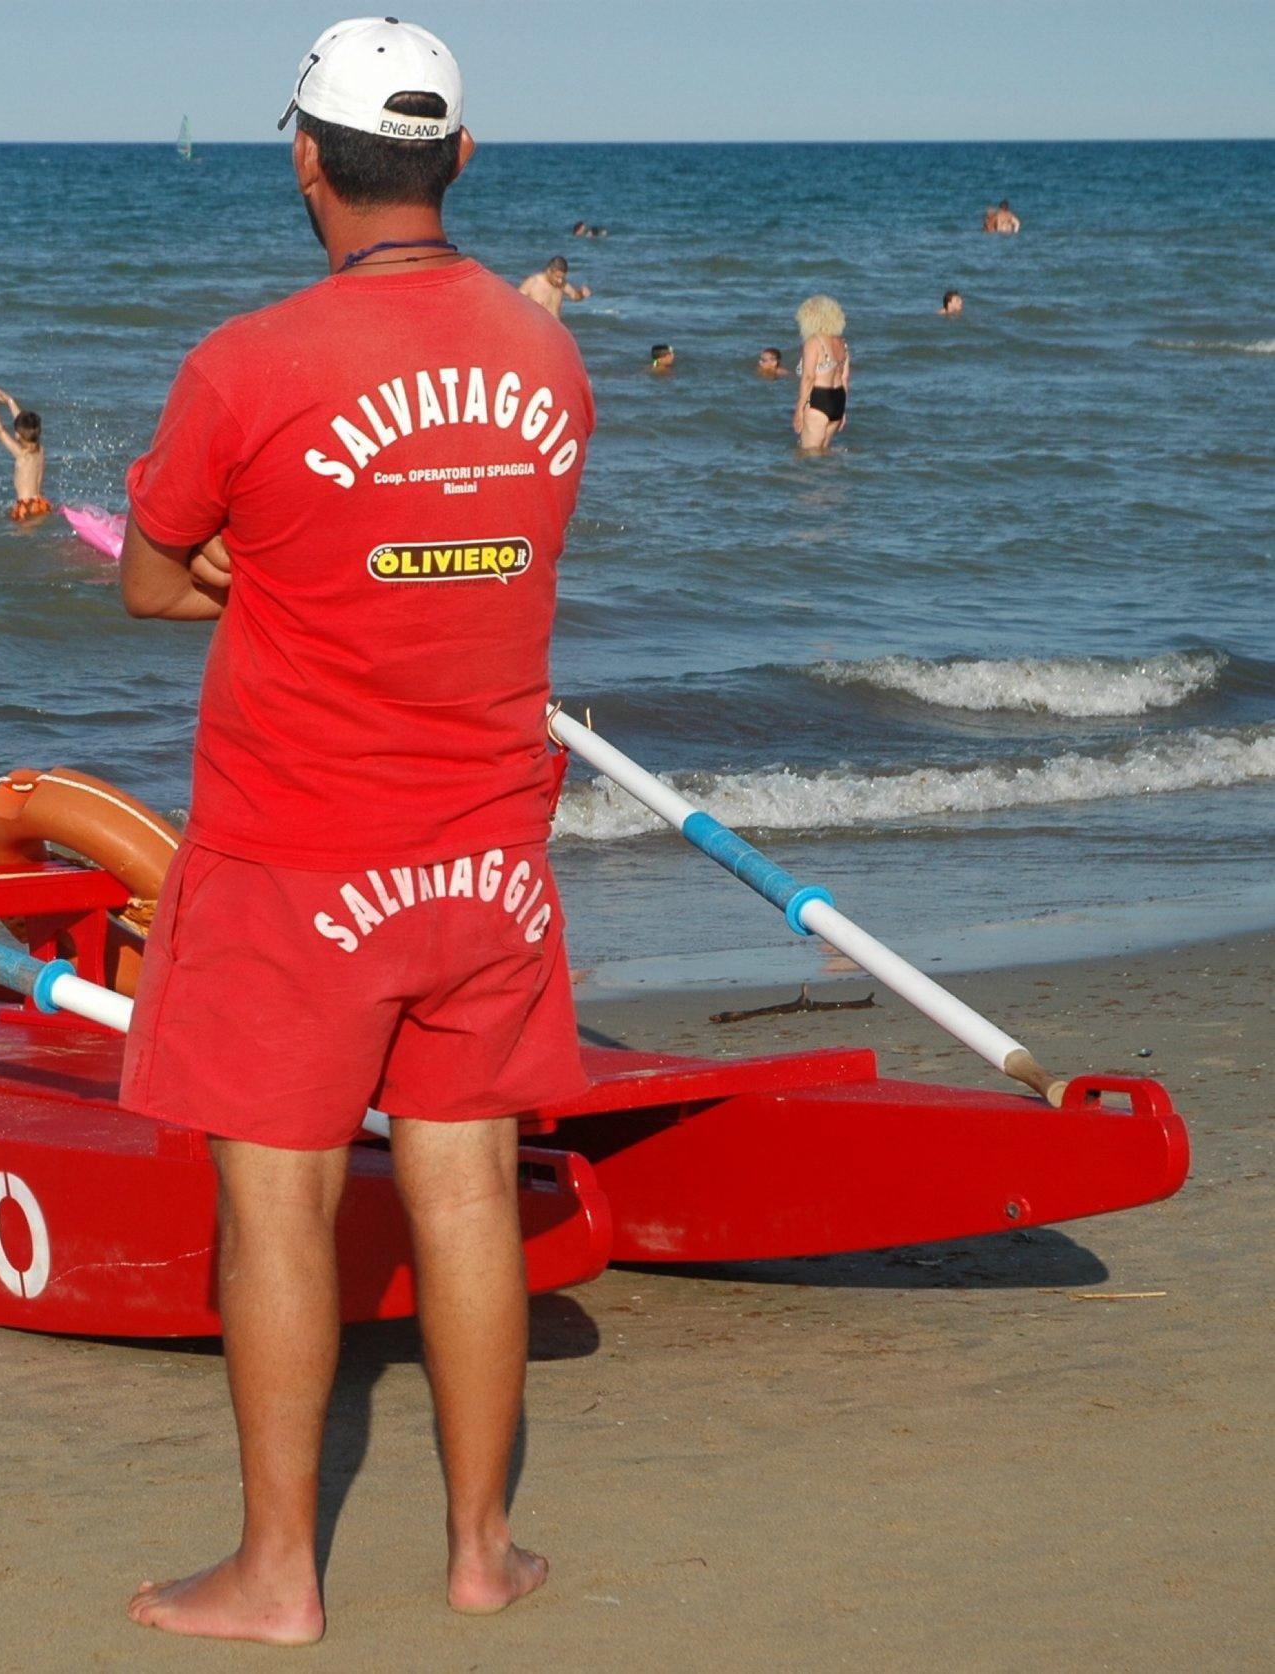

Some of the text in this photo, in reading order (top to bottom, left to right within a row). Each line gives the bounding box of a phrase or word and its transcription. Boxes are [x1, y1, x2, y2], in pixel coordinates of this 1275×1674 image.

[380, 120, 439, 136] ENGLAND
[304, 366, 579, 489] SALVATAGGIO
[373, 462, 535, 485] Coop. OPERATORI DI SPIAGGIA
[443, 481, 478, 495] Rimini
